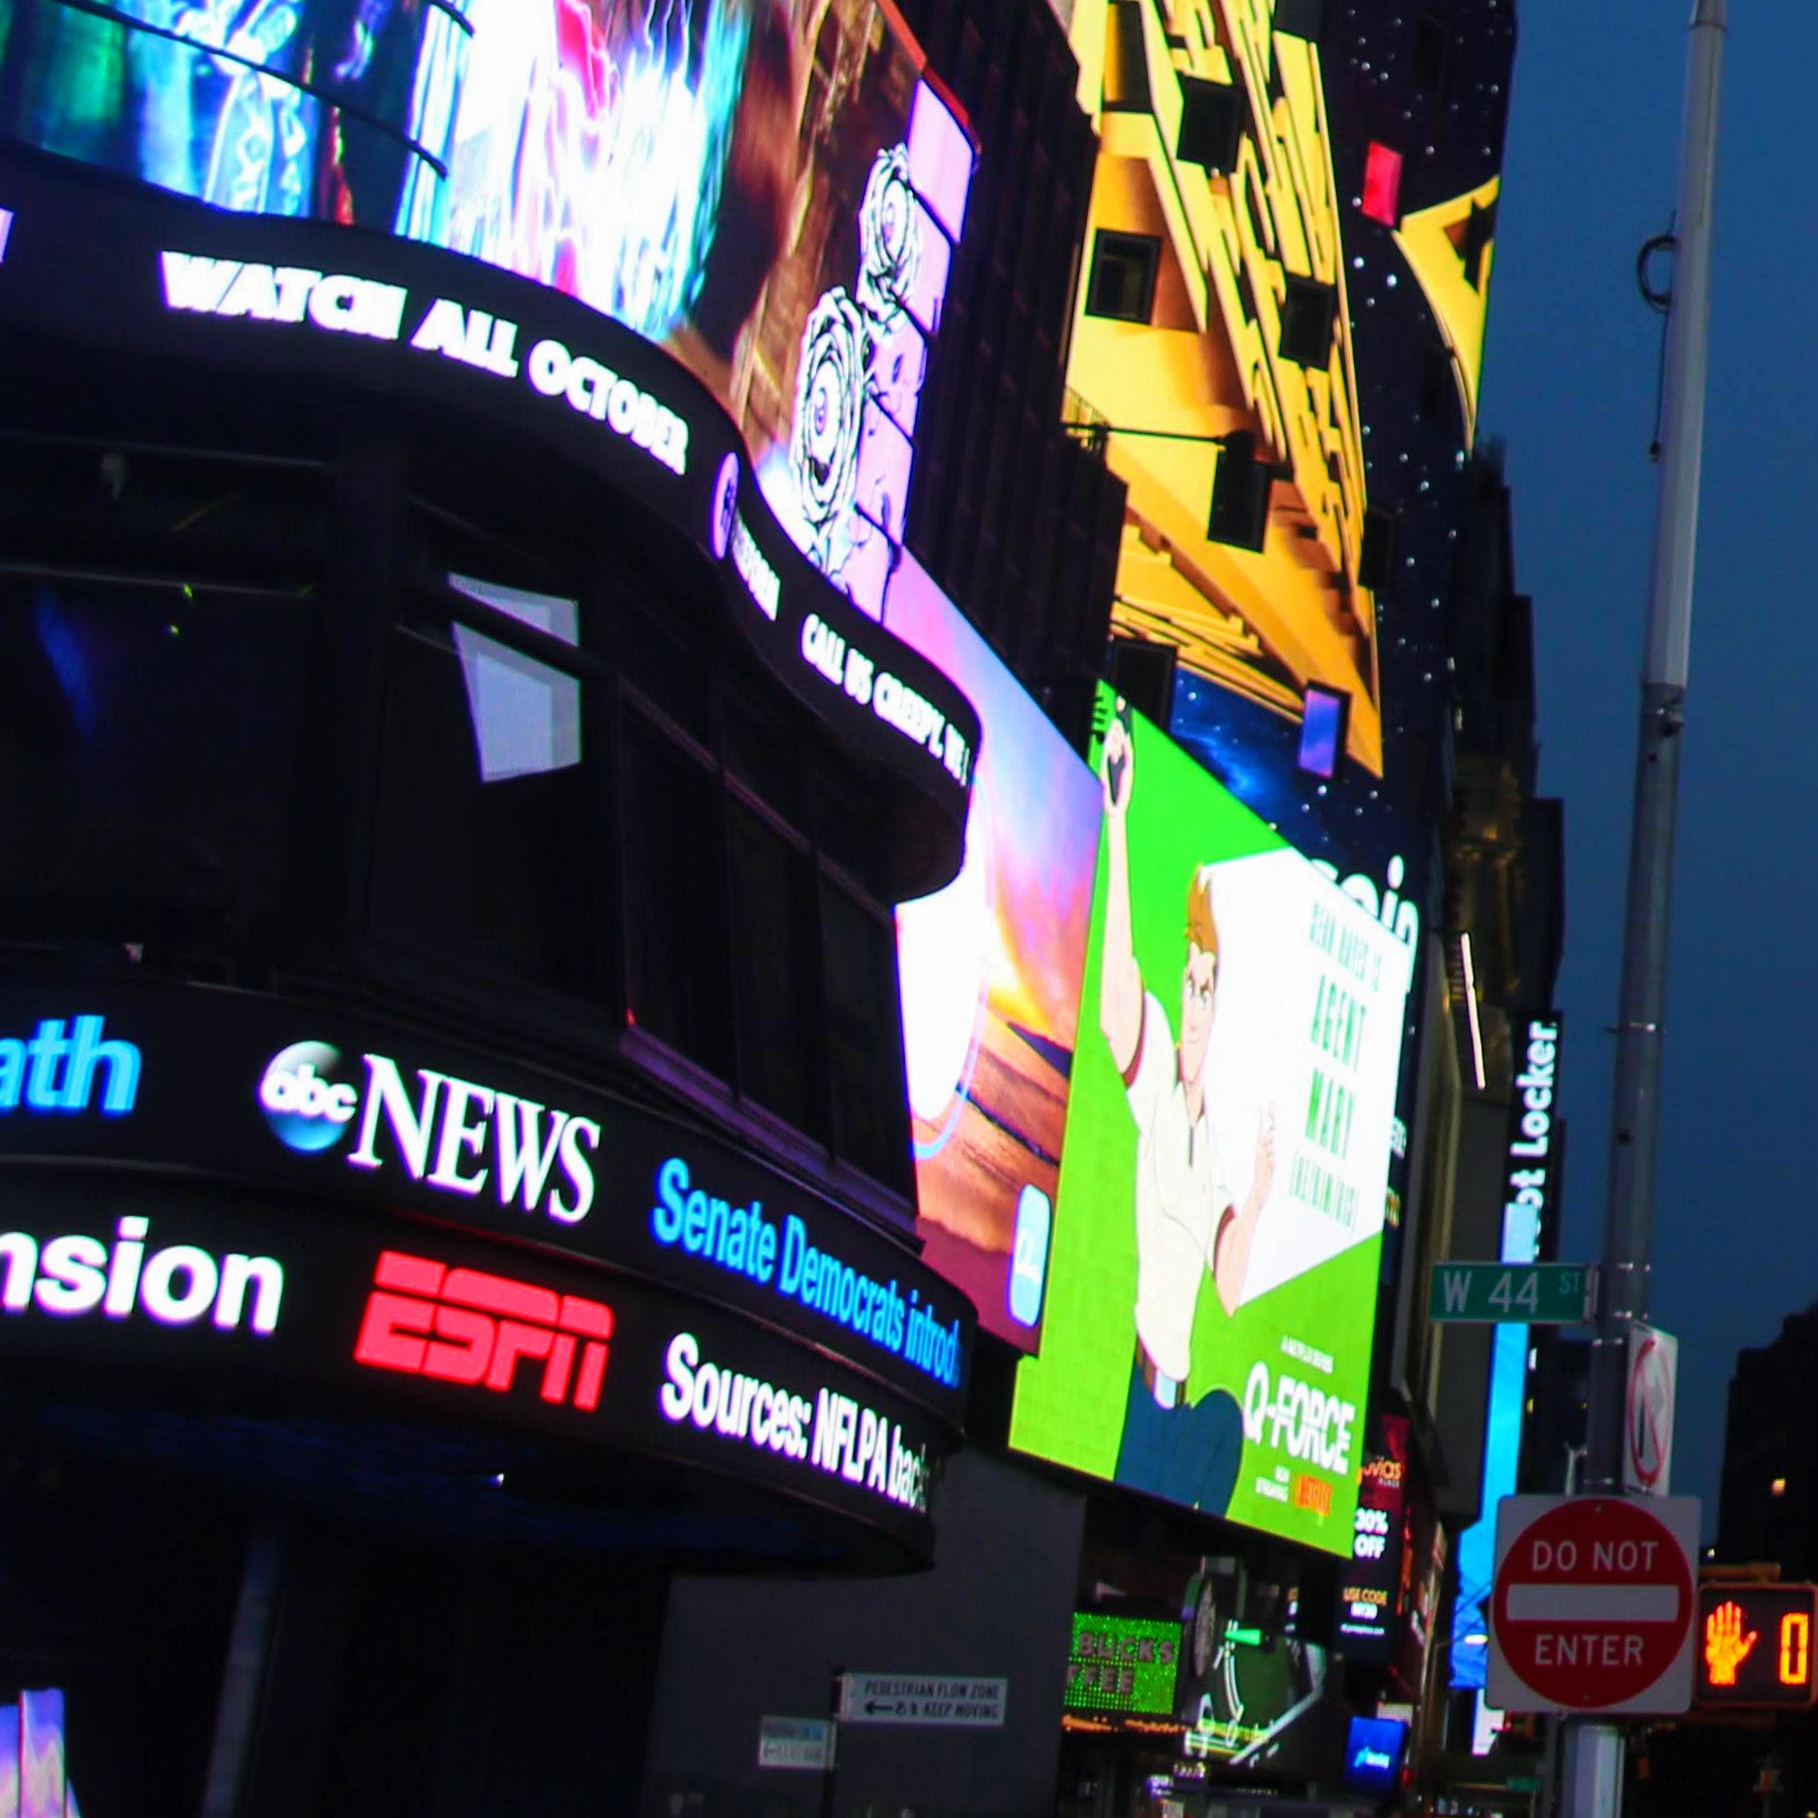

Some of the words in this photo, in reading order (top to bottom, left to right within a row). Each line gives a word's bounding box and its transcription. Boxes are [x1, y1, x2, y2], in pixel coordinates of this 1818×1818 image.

[160, 250, 407, 339] WATCH
[411, 297, 519, 379] ALL
[528, 338, 690, 476] OCTOBER
[1510, 1019, 1558, 1158] Locker
[260, 1063, 357, 1124] abc
[347, 1052, 601, 1226] NEWS
[652, 1157, 777, 1284] Senate
[779, 1213, 906, 1353] Democrats
[1443, 1270, 1472, 1314] W
[1488, 1271, 1540, 1315] 44
[1559, 1271, 1580, 1295] ST
[353, 1249, 614, 1412] ESPN
[660, 1332, 812, 1461] Sources:
[811, 1386, 889, 1494] NFLPA
[1243, 1360, 1357, 1476] Q-FORCE
[1353, 1536, 1386, 1559] OFF
[1531, 1540, 1577, 1572] DO
[1592, 1540, 1659, 1572] NOT
[864, 1679, 936, 1698] PEDESTRIAN
[937, 1681, 968, 1699] FLOW
[969, 1682, 1000, 1701] ZONE
[1534, 1634, 1644, 1667] ENTER
[1779, 1612, 1809, 1685] 0
[923, 1701, 953, 1719] KEEP
[954, 1701, 999, 1720] MOVING
